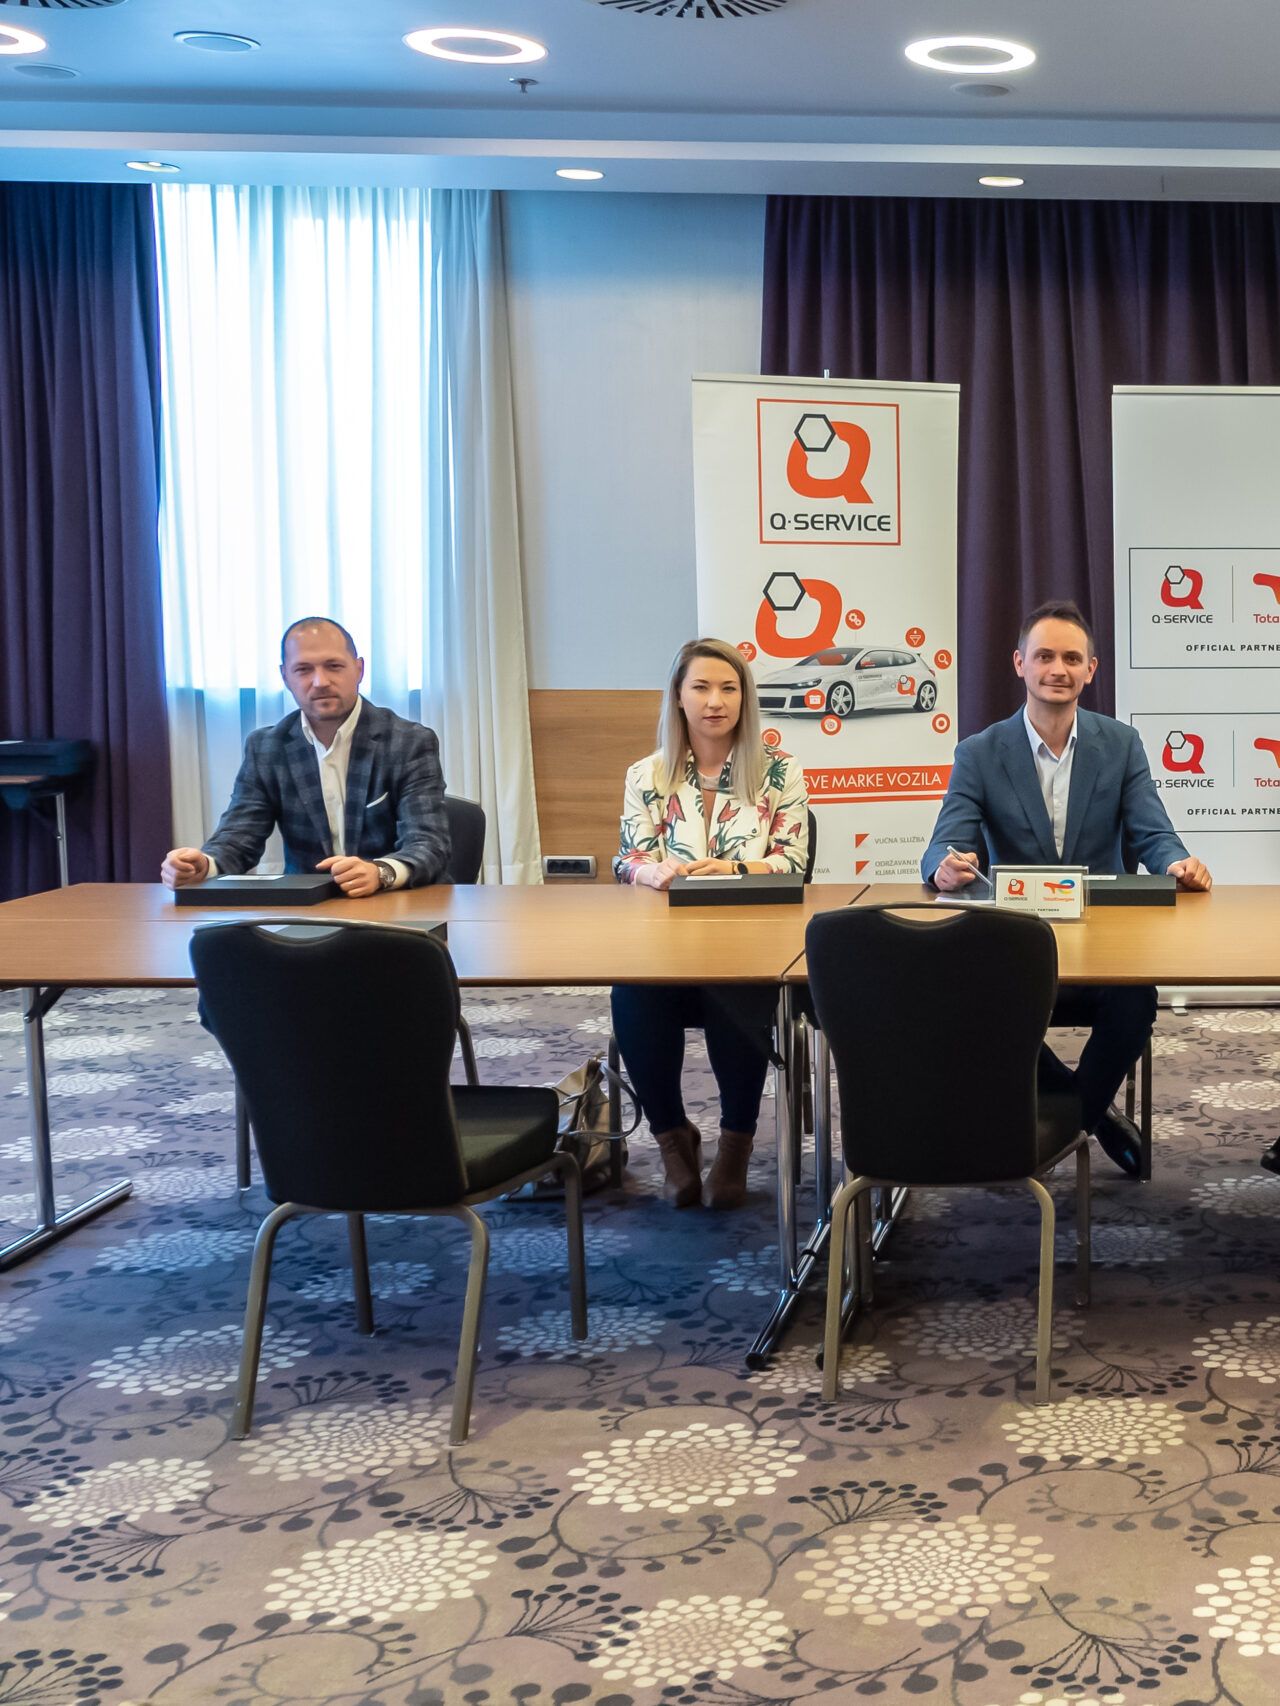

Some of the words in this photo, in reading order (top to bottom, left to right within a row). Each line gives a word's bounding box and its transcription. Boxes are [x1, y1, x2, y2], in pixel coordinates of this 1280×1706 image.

[1185, 644, 1236, 652] OFFICIAL
[803, 774, 829, 789] SVE
[832, 773, 884, 788] MARKE
[886, 771, 942, 786] VOZILA
[1187, 808, 1237, 816] OFFICIAL
